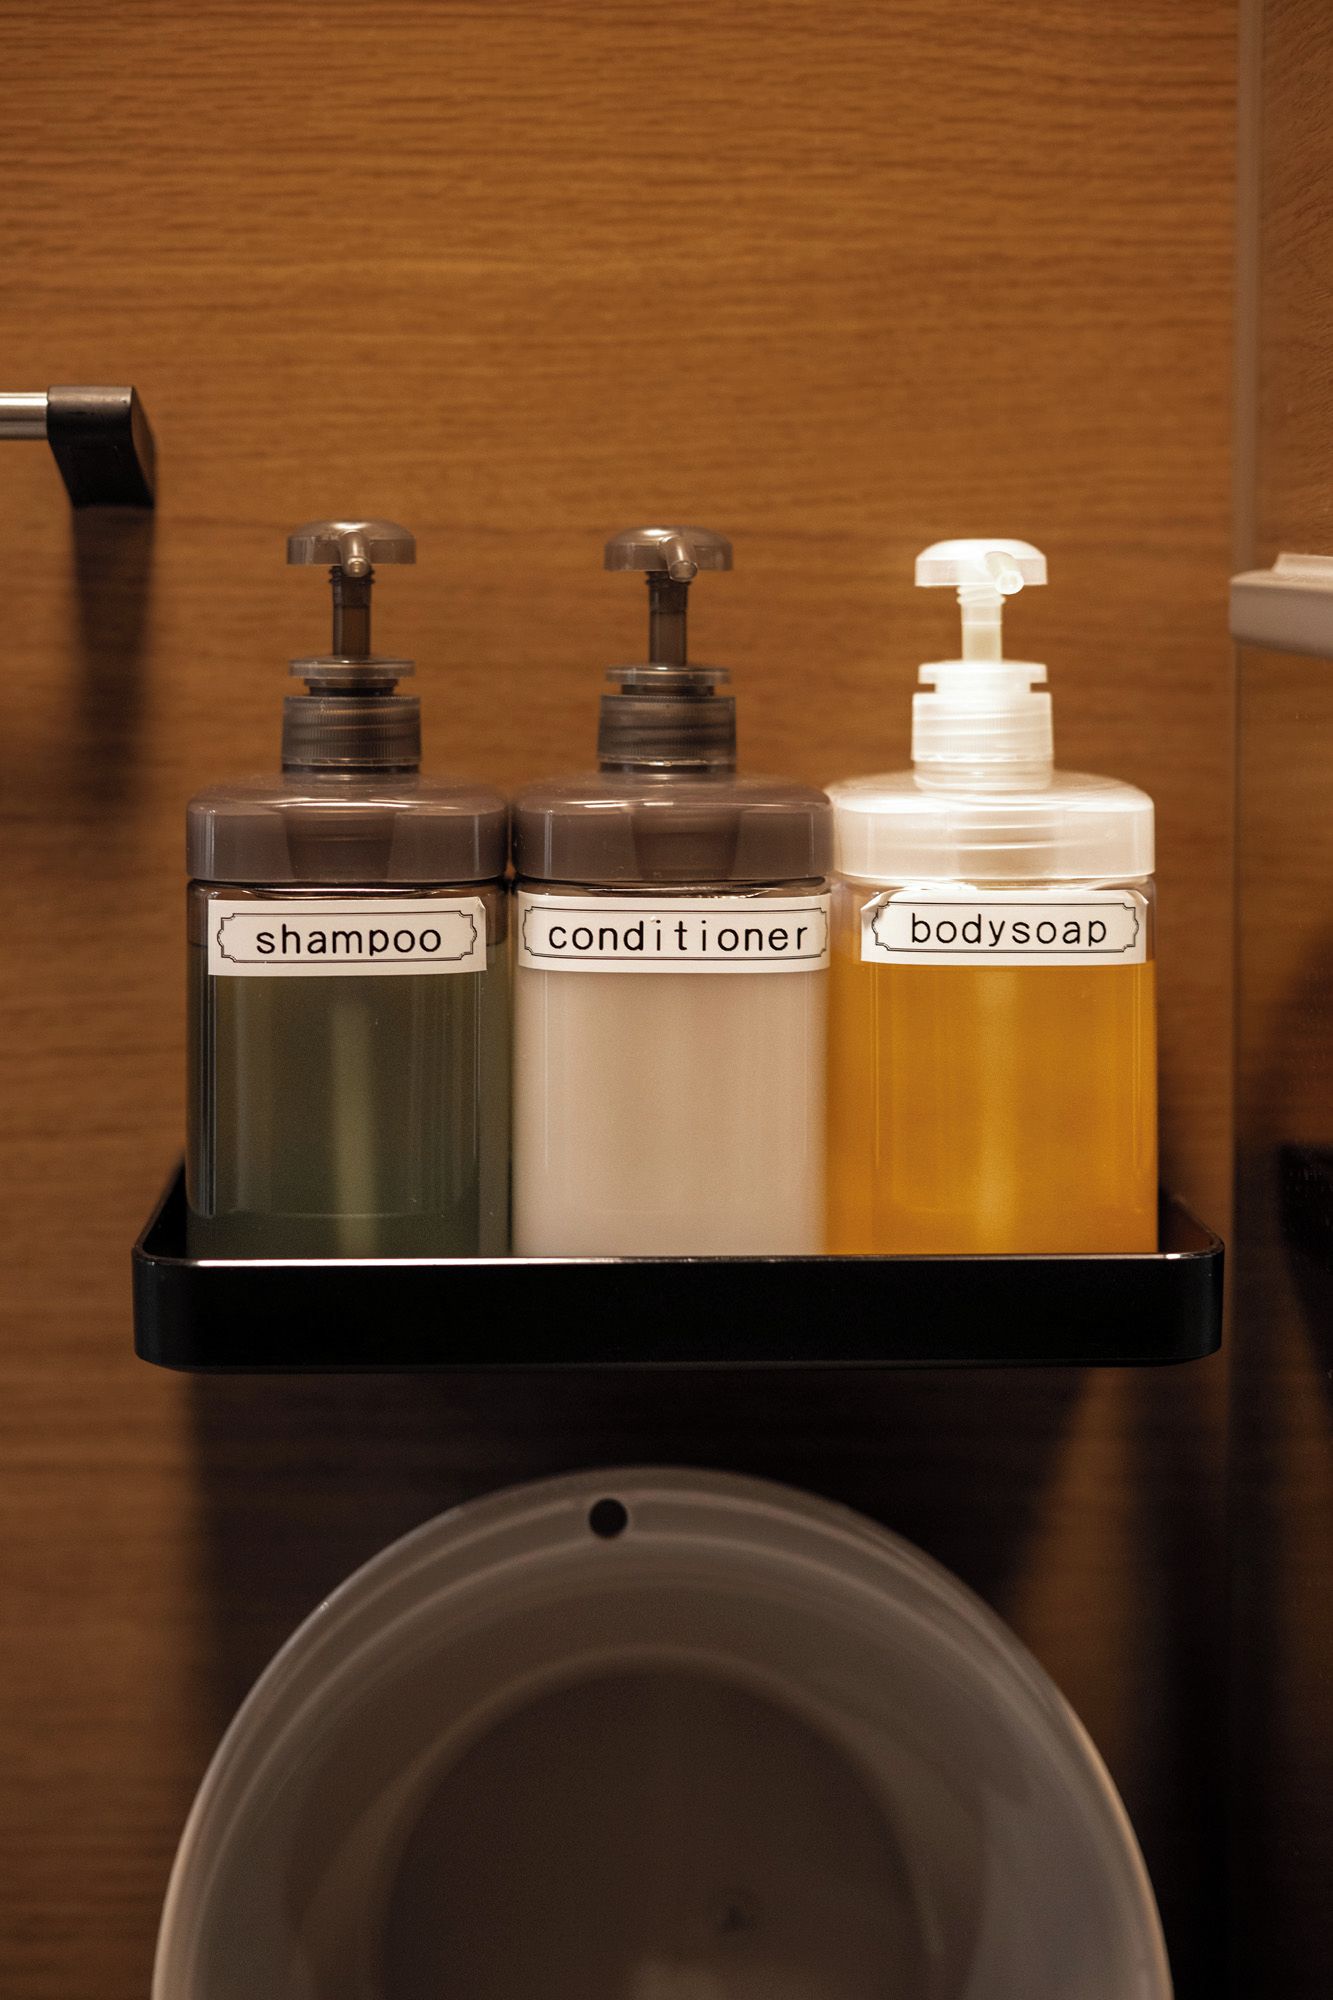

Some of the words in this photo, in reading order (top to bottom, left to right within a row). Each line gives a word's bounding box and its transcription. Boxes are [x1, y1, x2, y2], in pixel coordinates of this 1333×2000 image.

[255, 923, 442, 957] shampoo
[548, 919, 808, 952] conditioner
[911, 912, 1107, 948] bodysoap
